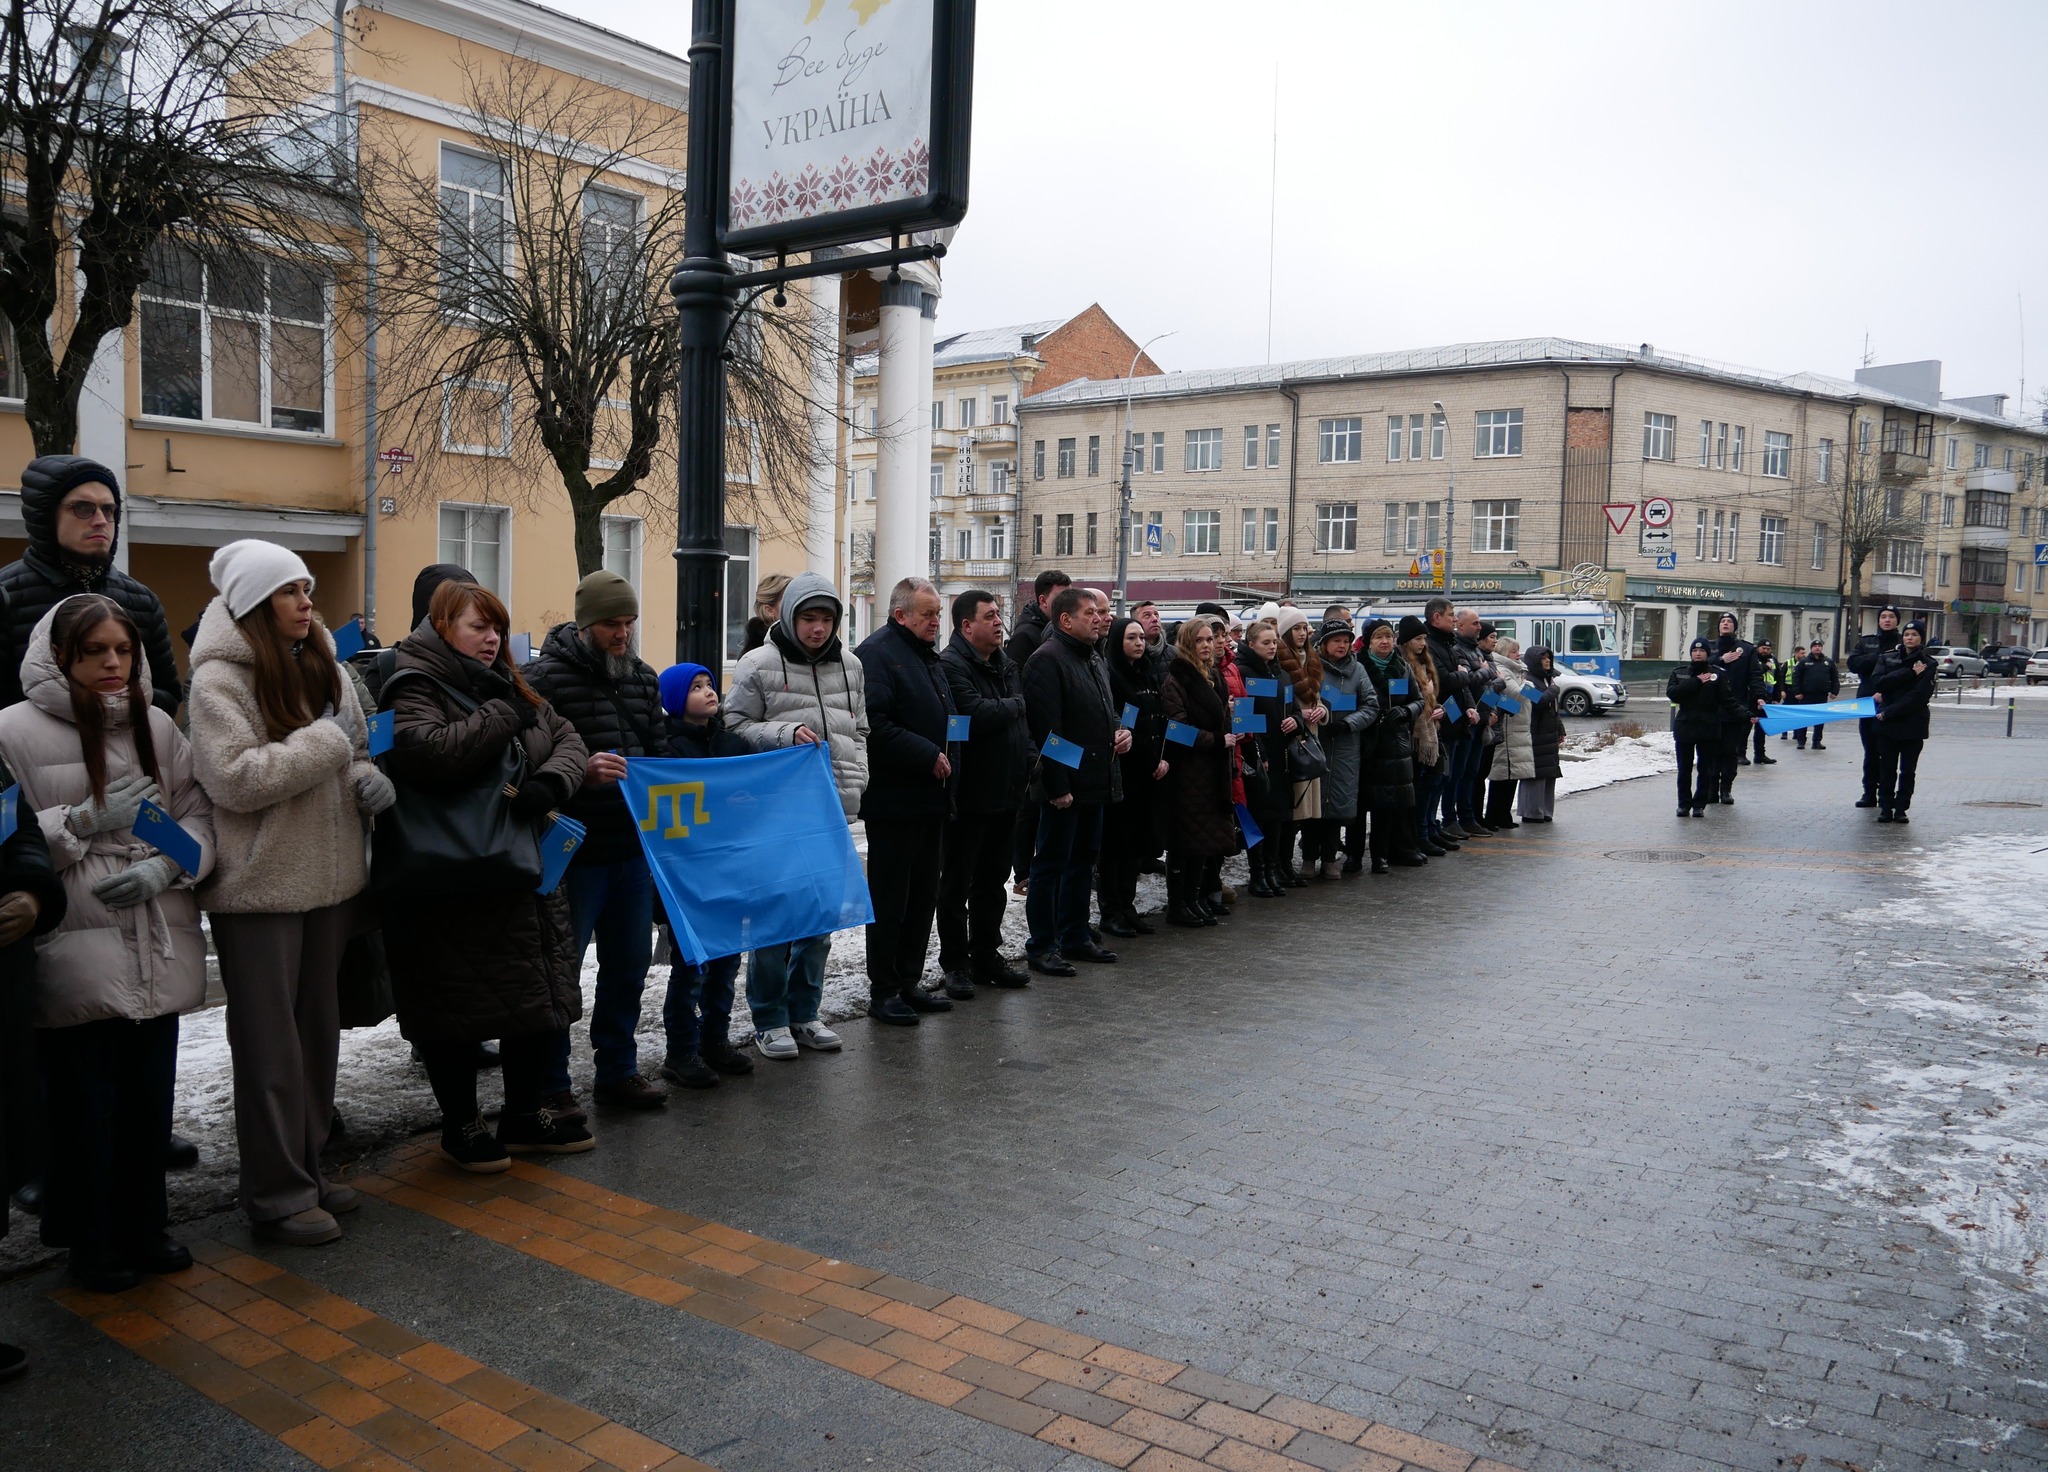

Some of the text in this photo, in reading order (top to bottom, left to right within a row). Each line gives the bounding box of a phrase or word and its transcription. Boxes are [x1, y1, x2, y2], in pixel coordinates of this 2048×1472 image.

[771, 29, 888, 96] Все буде
[762, 88, 893, 150] УКРАЇНА
[391, 464, 401, 472] 25
[381, 499, 394, 512] 25
[1462, 580, 1502, 590] САЛОН
